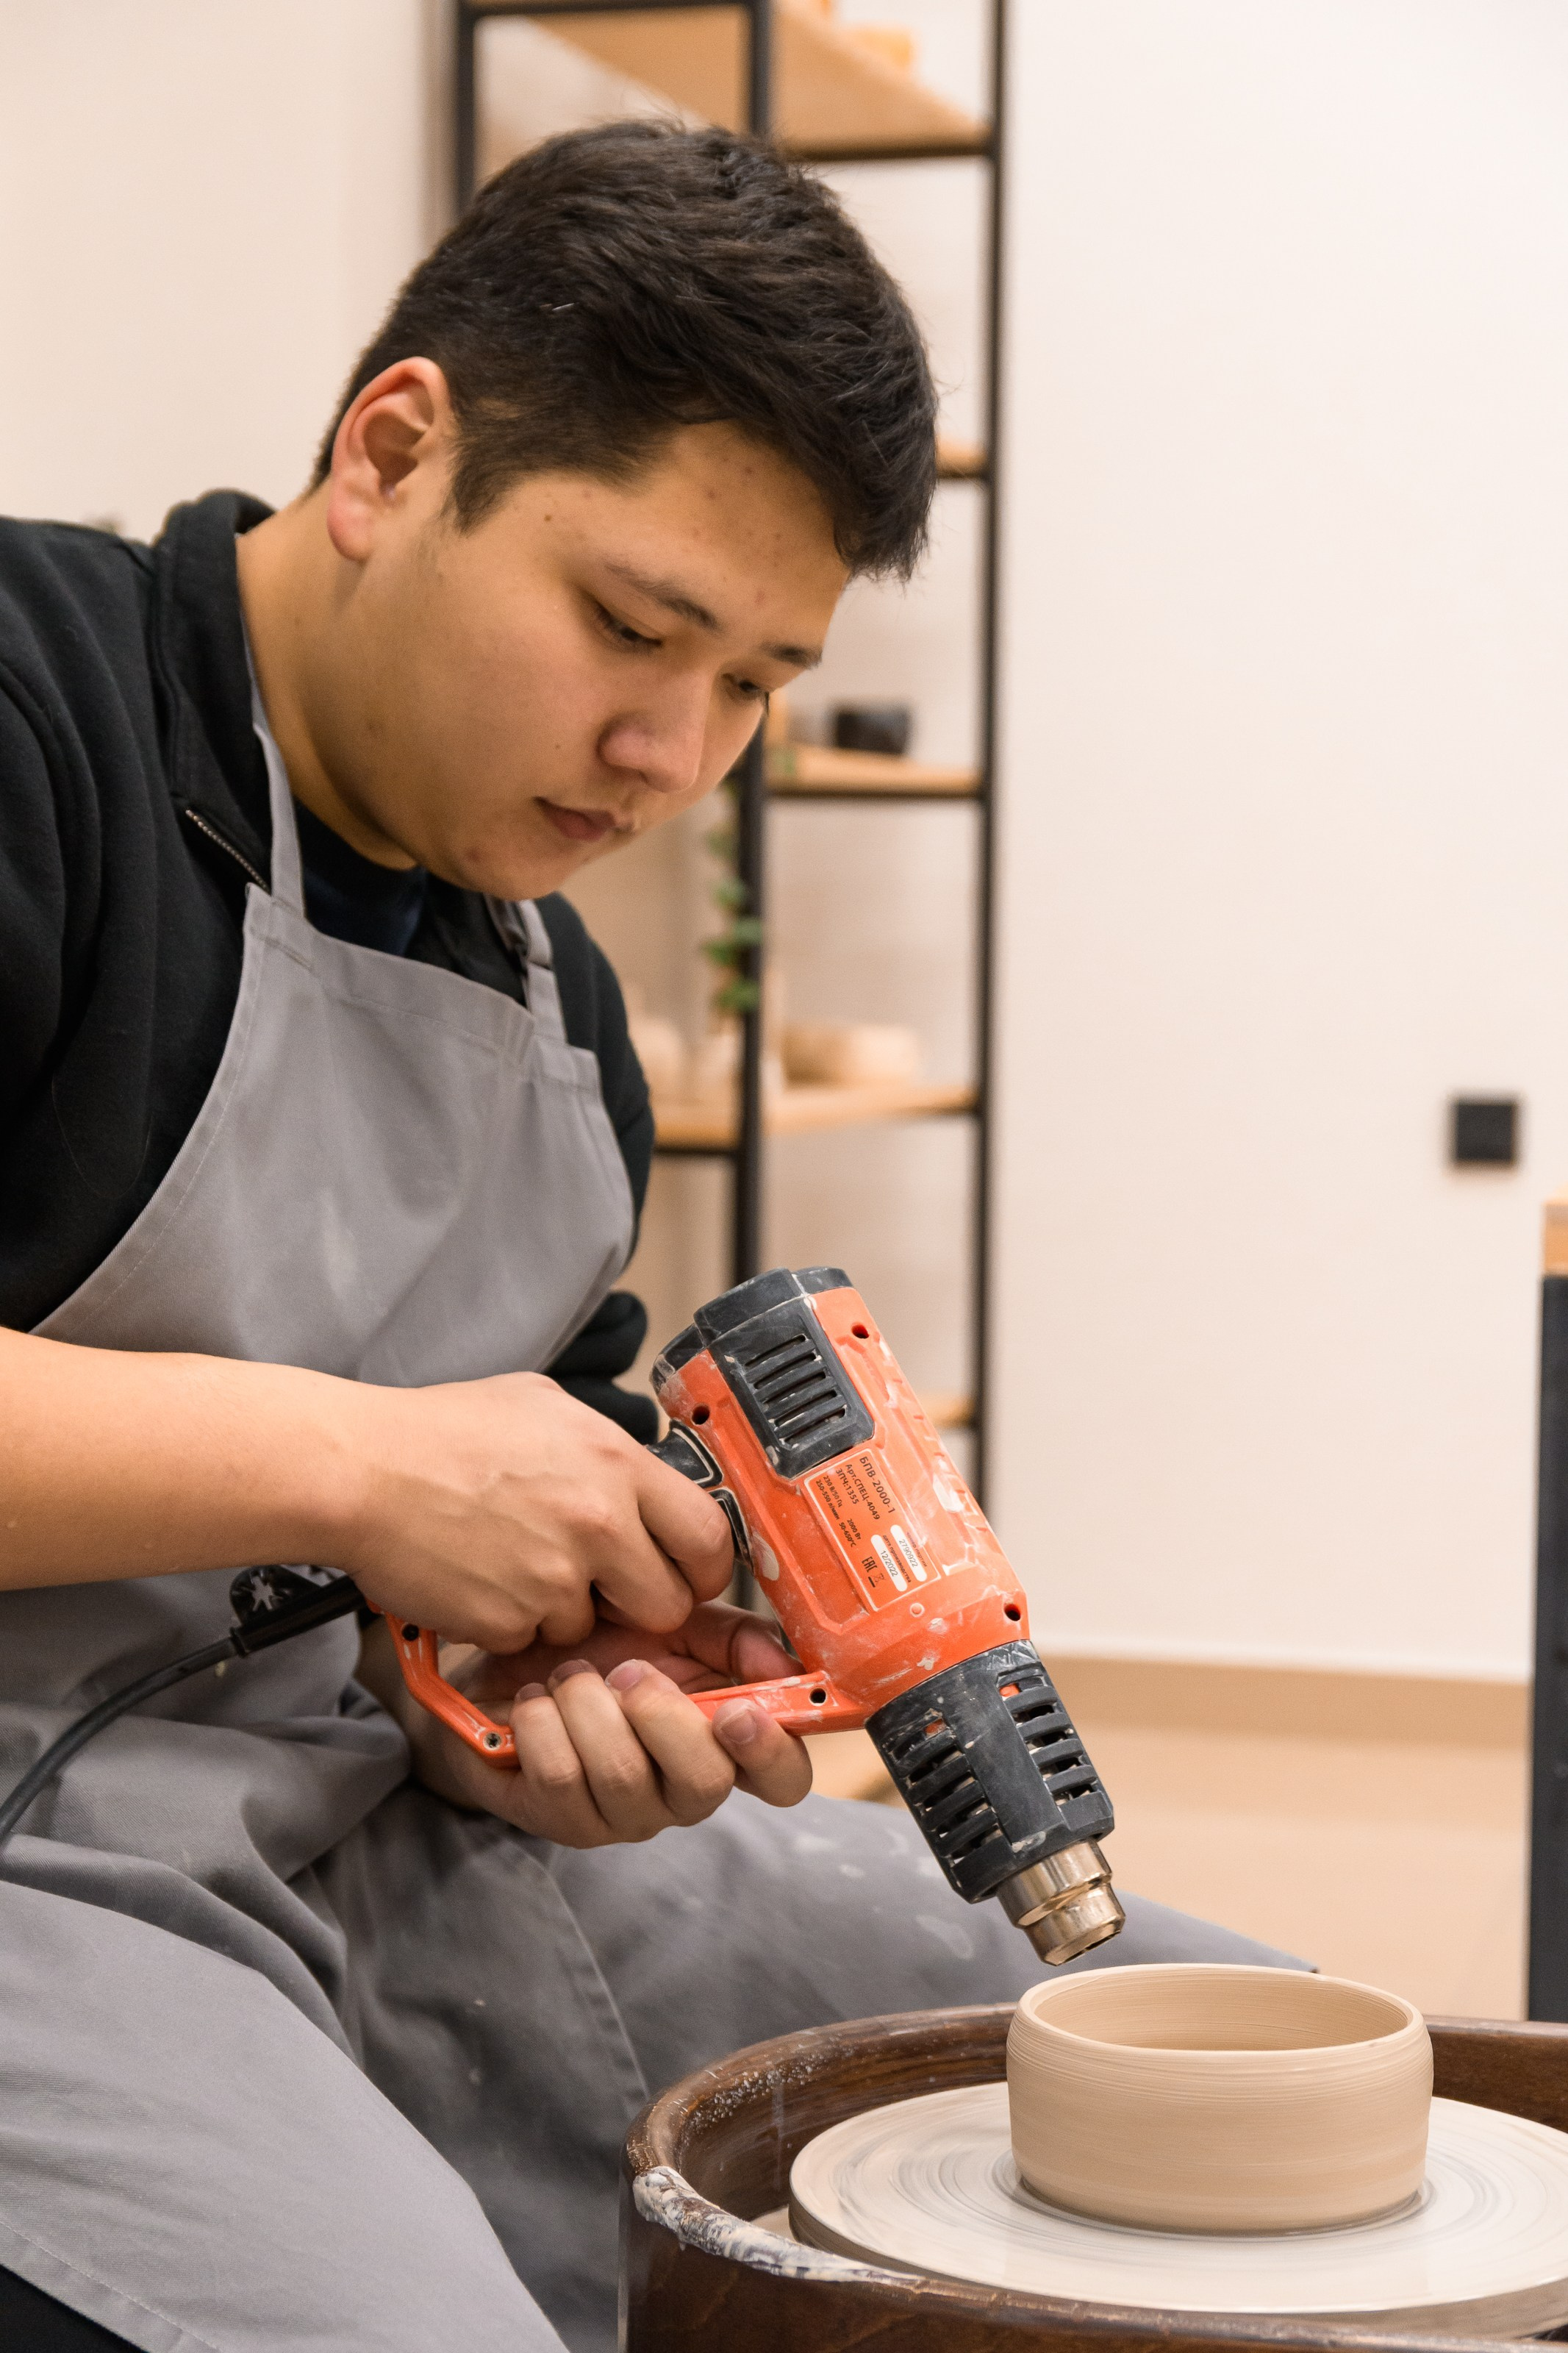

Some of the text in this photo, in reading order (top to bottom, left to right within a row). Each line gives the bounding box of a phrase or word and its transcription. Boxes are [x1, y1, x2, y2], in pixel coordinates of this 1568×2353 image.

[815, 1479, 831, 1503] 250-550
[823, 1475, 833, 1487] 230
[845, 1464, 881, 1520] Арт.СПЕЦ-4049
[859, 1456, 895, 1513] БПВ-2000-1
[846, 1518, 862, 1540] 2000 Вт
[880, 1550, 898, 1577] 12/2022
[898, 1538, 918, 1568] 2790922
